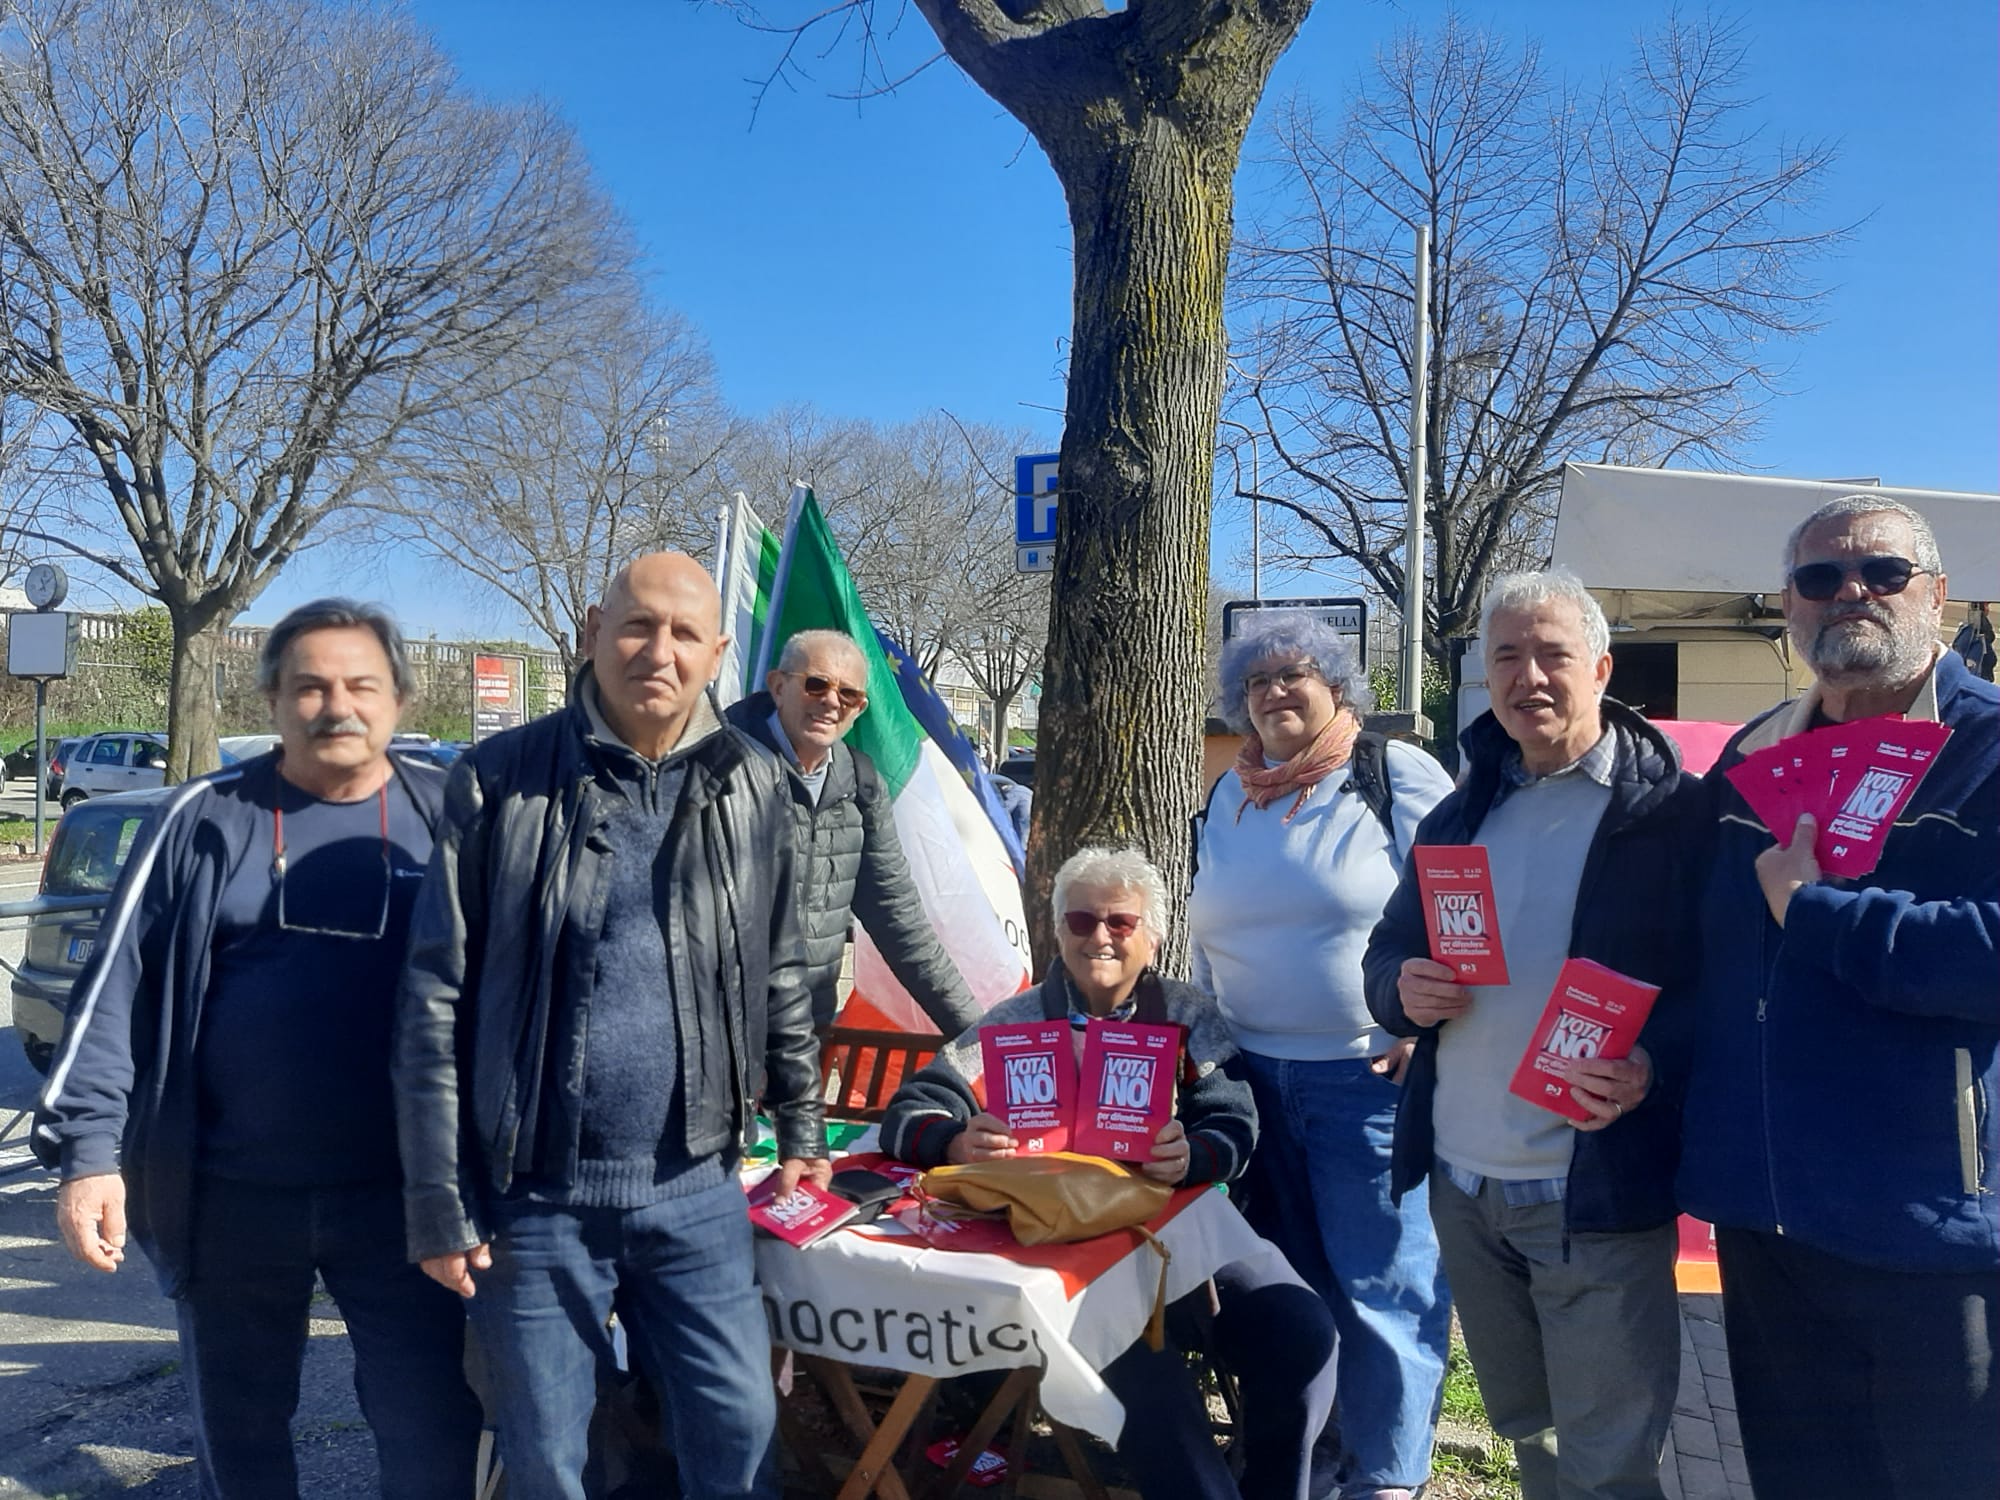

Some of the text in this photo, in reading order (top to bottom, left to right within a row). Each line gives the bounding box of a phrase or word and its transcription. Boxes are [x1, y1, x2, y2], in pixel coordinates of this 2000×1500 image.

[1864, 771, 1904, 794] VOTA
[1847, 789, 1893, 820] NO
[1436, 895, 1478, 911] VOTA
[1440, 910, 1483, 936] NO
[1559, 1014, 1604, 1042] VOTA
[1548, 1030, 1598, 1058] NO
[1007, 1056, 1050, 1076] VOTA
[1108, 1057, 1149, 1078] VOTA
[1010, 1073, 1054, 1104] NO
[1104, 1074, 1149, 1108] NO
